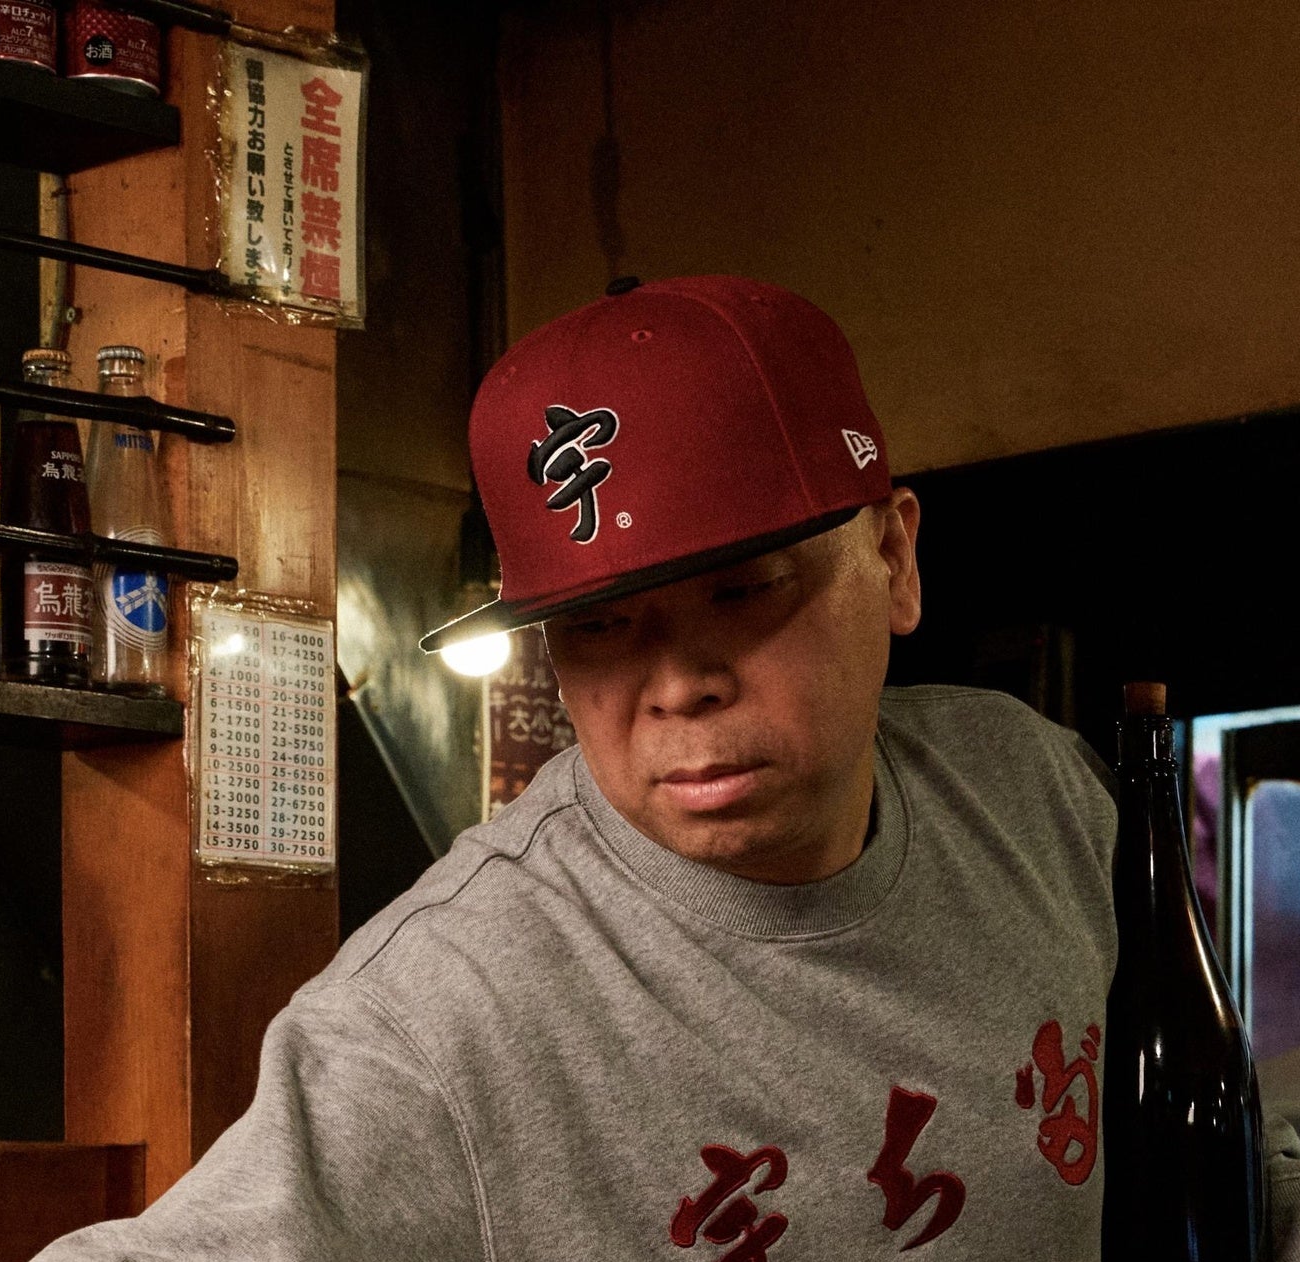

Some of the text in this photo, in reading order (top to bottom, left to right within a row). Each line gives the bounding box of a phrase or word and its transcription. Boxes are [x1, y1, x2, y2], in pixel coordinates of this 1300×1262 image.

[85, 44, 113, 60] お酒
[301, 77, 343, 300] 全席禁煙
[282, 142, 294, 298] とさせて頂いておりす
[527, 404, 620, 544] 宇
[271, 631, 324, 648] 16-4000
[271, 646, 324, 663] 17-4250
[271, 675, 324, 693] 19-4750
[209, 683, 324, 707] 5-1250 20-5000
[209, 698, 324, 722] 6-1500 21-5250
[209, 712, 324, 737] 7-1750 22-5500
[209, 728, 324, 752] 8-2000 23-5750
[209, 744, 324, 767] 9-2250 24-6000
[271, 766, 324, 782] 25-6250
[271, 781, 324, 797] 26-6500
[271, 797, 324, 812] 27-6750
[271, 812, 324, 827] 28-7000
[271, 827, 324, 842] 29-7250
[271, 842, 324, 857] 30-7500
